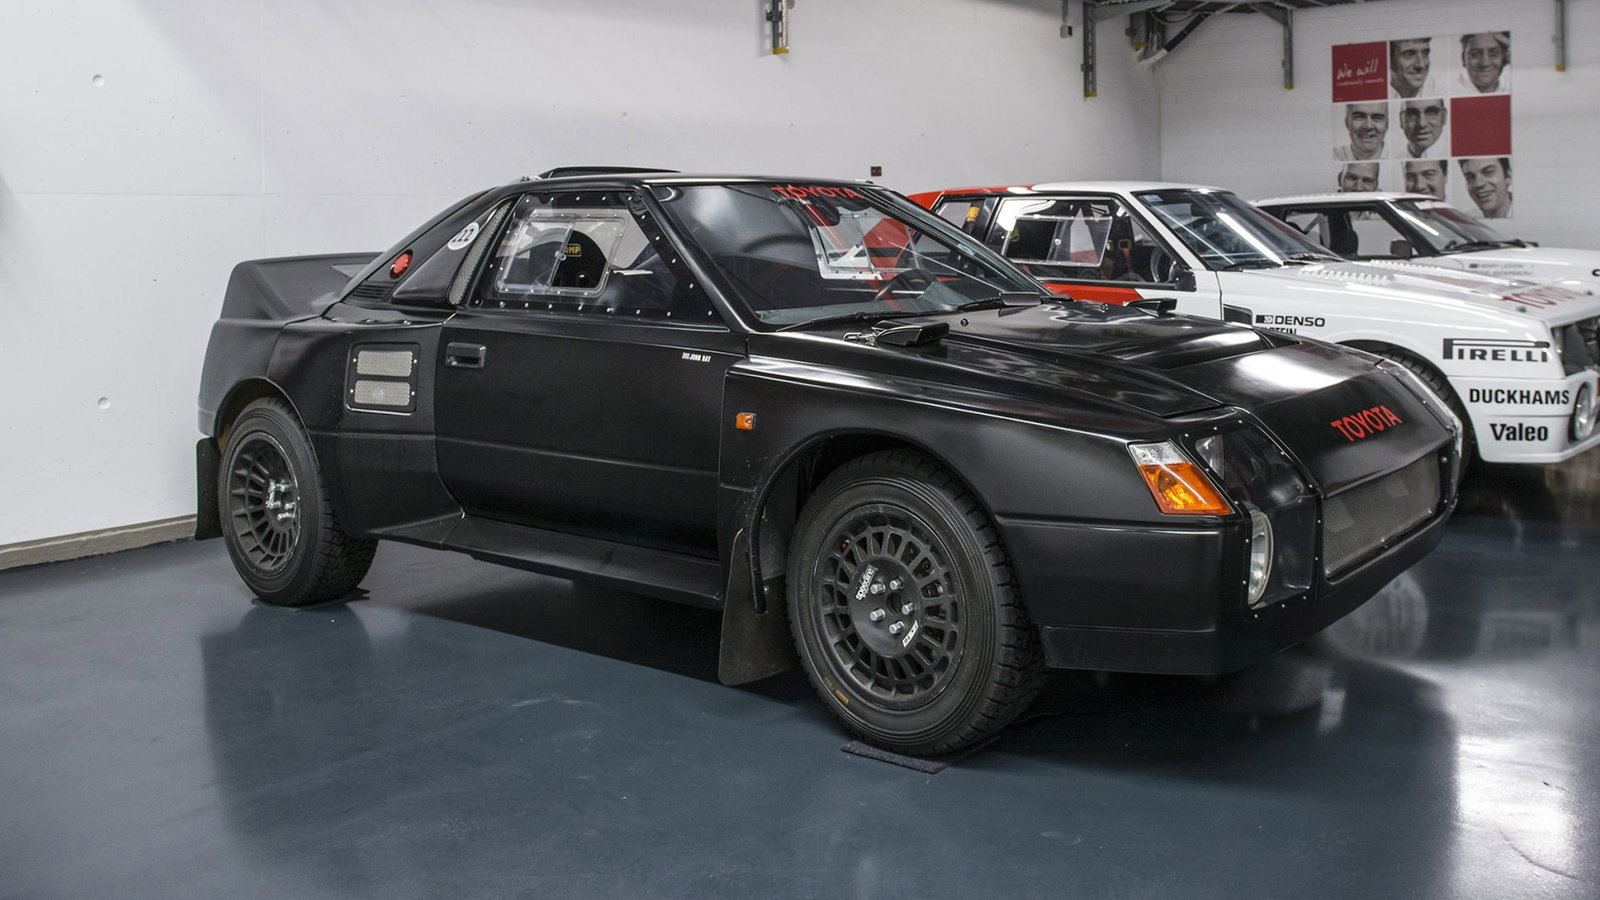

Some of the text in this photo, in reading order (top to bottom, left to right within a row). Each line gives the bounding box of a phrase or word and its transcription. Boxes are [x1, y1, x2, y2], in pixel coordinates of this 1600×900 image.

[1337, 59, 1377, 80] We will
[770, 186, 864, 198] TOYOTA
[563, 246, 580, 254] OMP
[1274, 315, 1325, 327] DENSO
[1443, 338, 1550, 363] PIRELLI
[1469, 388, 1570, 405] DUCKHAMS
[1330, 405, 1403, 442] TOYOTA
[1490, 422, 1549, 442] Valeo
